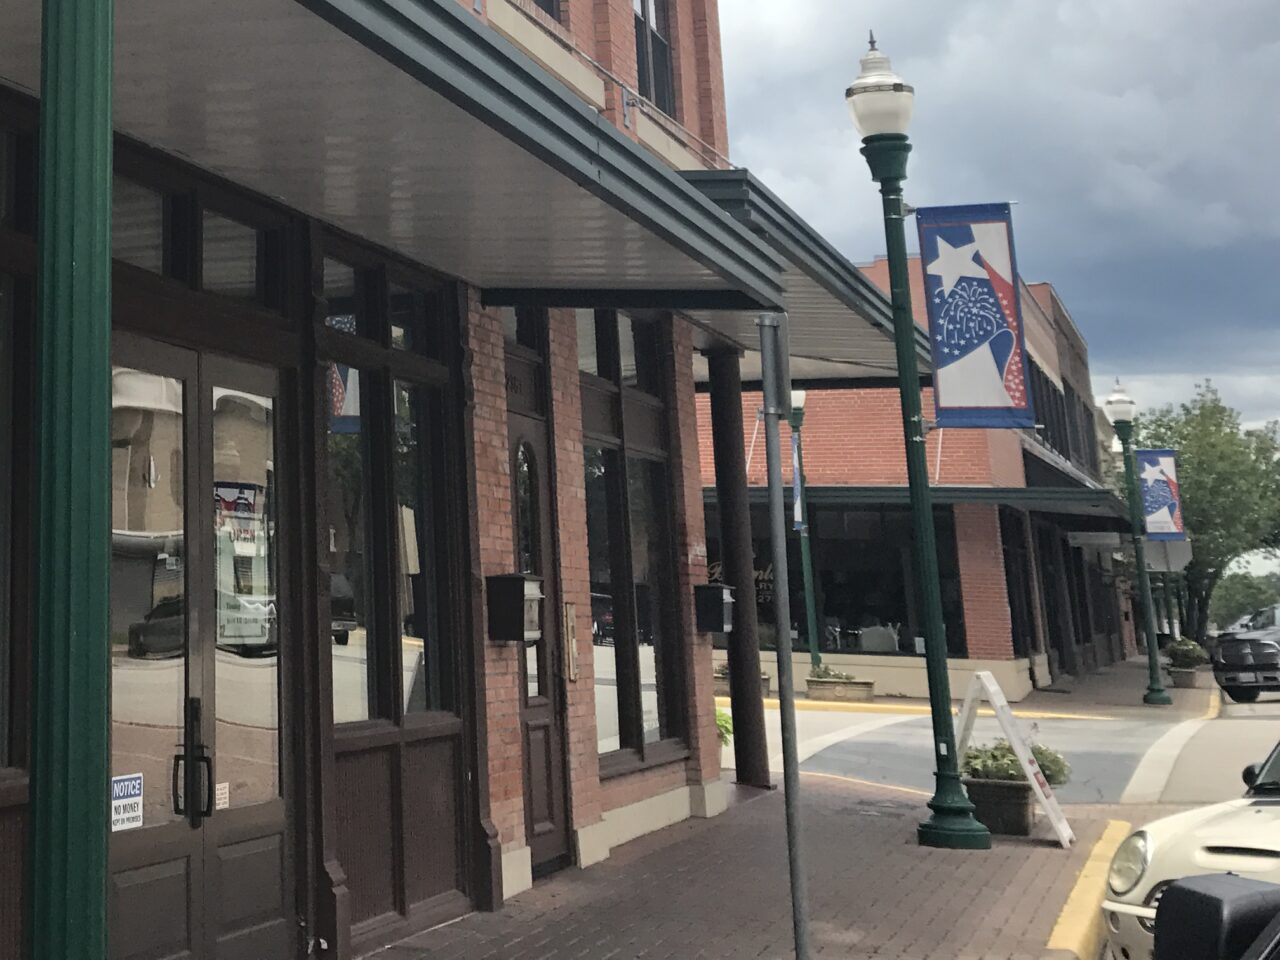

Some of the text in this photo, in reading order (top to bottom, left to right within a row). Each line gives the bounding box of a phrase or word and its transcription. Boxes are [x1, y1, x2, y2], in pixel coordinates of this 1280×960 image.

[113, 779, 141, 798] NOTICE
[114, 802, 139, 815] NO MONEY
